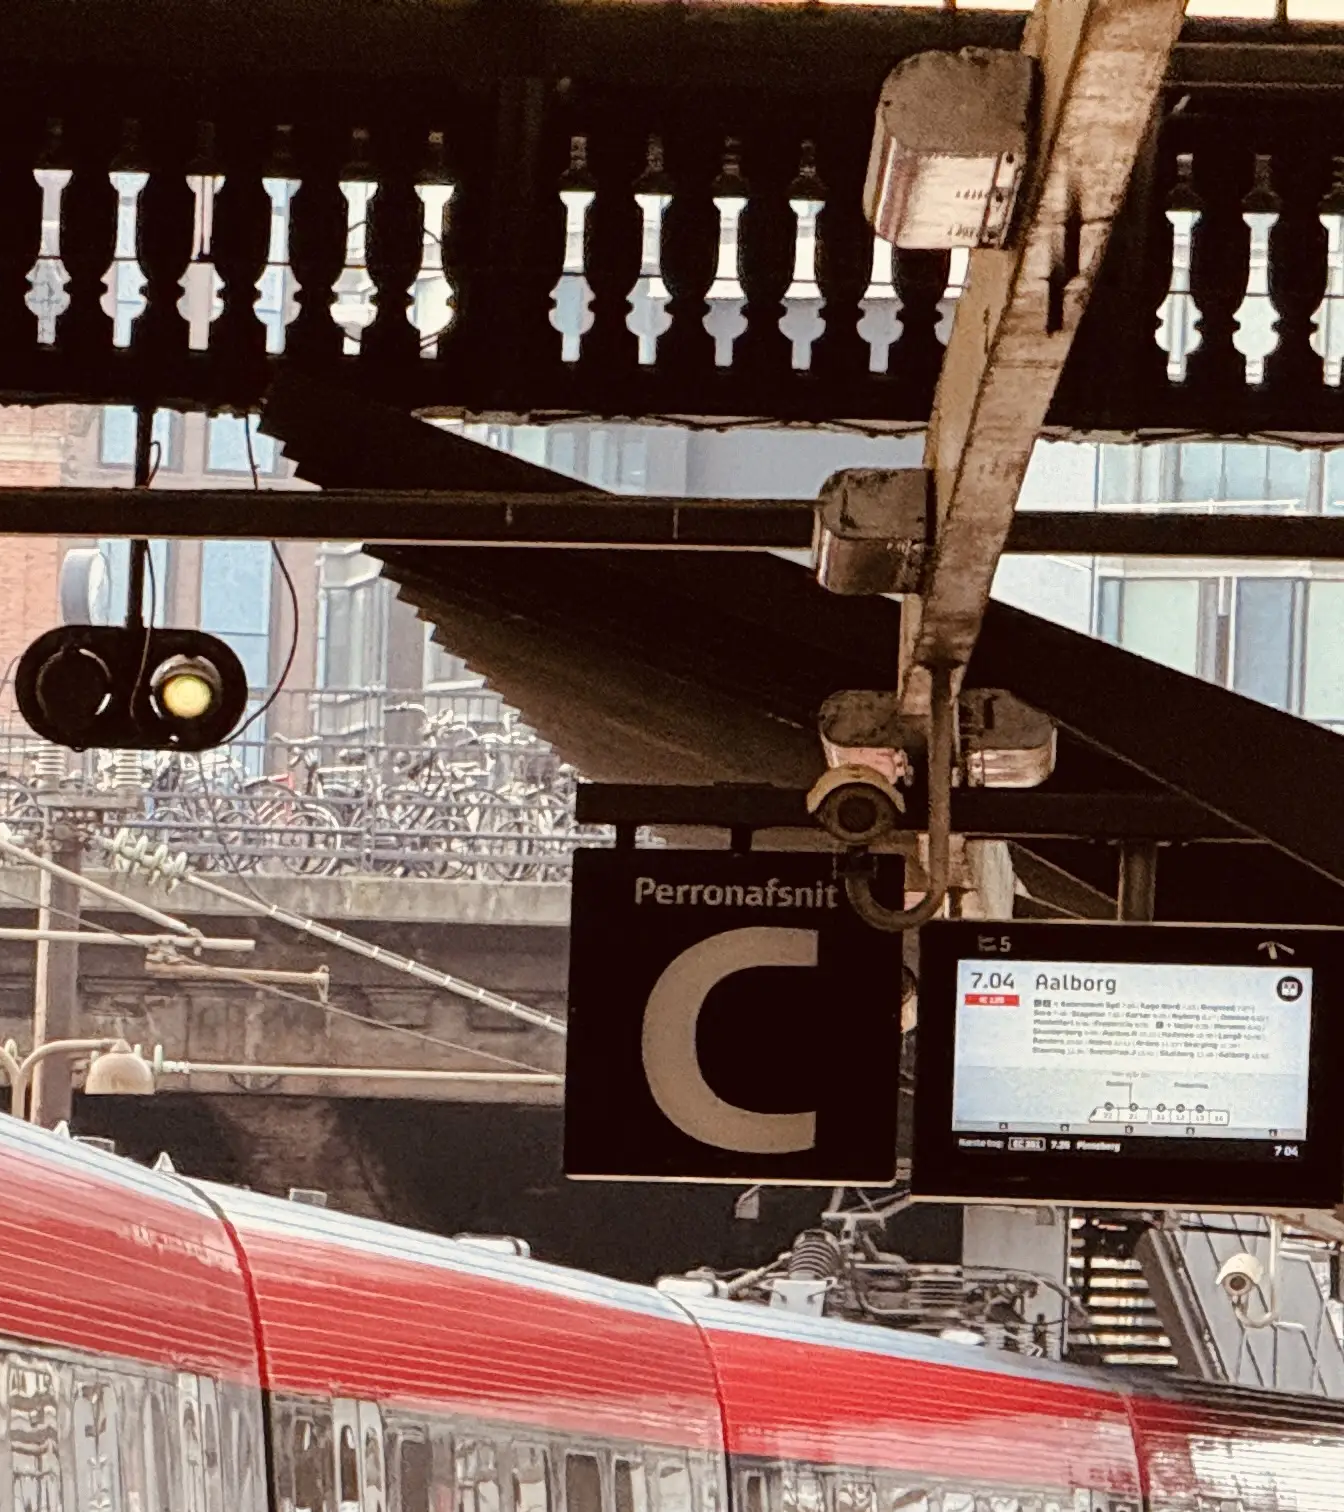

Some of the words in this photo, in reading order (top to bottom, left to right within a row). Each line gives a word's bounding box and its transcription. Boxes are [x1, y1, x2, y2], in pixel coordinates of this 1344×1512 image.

[634, 876, 838, 909] Perronafsnit
[970, 972, 1015, 989] 7.04
[1035, 974, 1117, 995] Aalborg
[641, 926, 819, 1154] C
